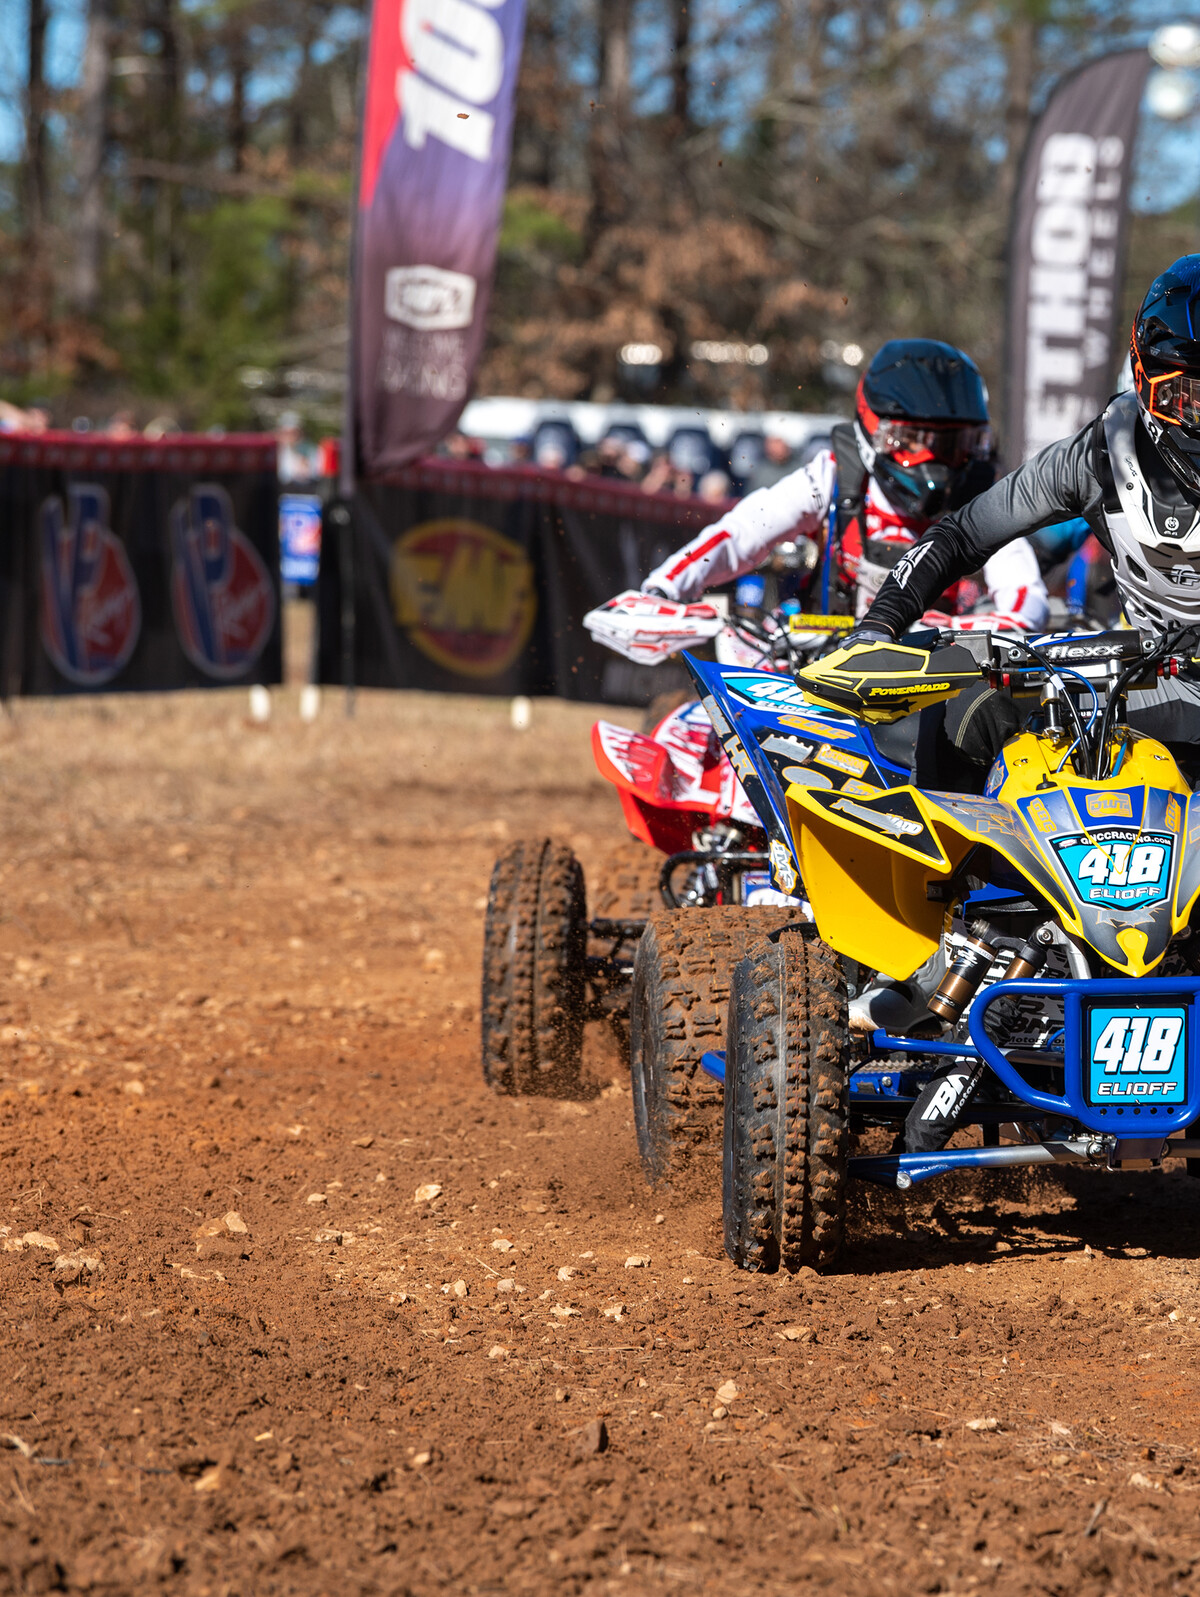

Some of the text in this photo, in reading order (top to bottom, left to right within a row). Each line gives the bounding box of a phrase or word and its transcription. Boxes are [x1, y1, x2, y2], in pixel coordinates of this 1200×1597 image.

[394, 0, 506, 163] 10
[1046, 645, 1124, 660] flexx
[1026, 797, 1057, 833] GBC
[1081, 831, 1171, 846] GNCCRACING.COM
[1079, 843, 1165, 886] 418
[1089, 887, 1161, 899] ELIOFF
[1093, 1016, 1183, 1074] 418
[1098, 1082, 1177, 1096] ELIOFF
